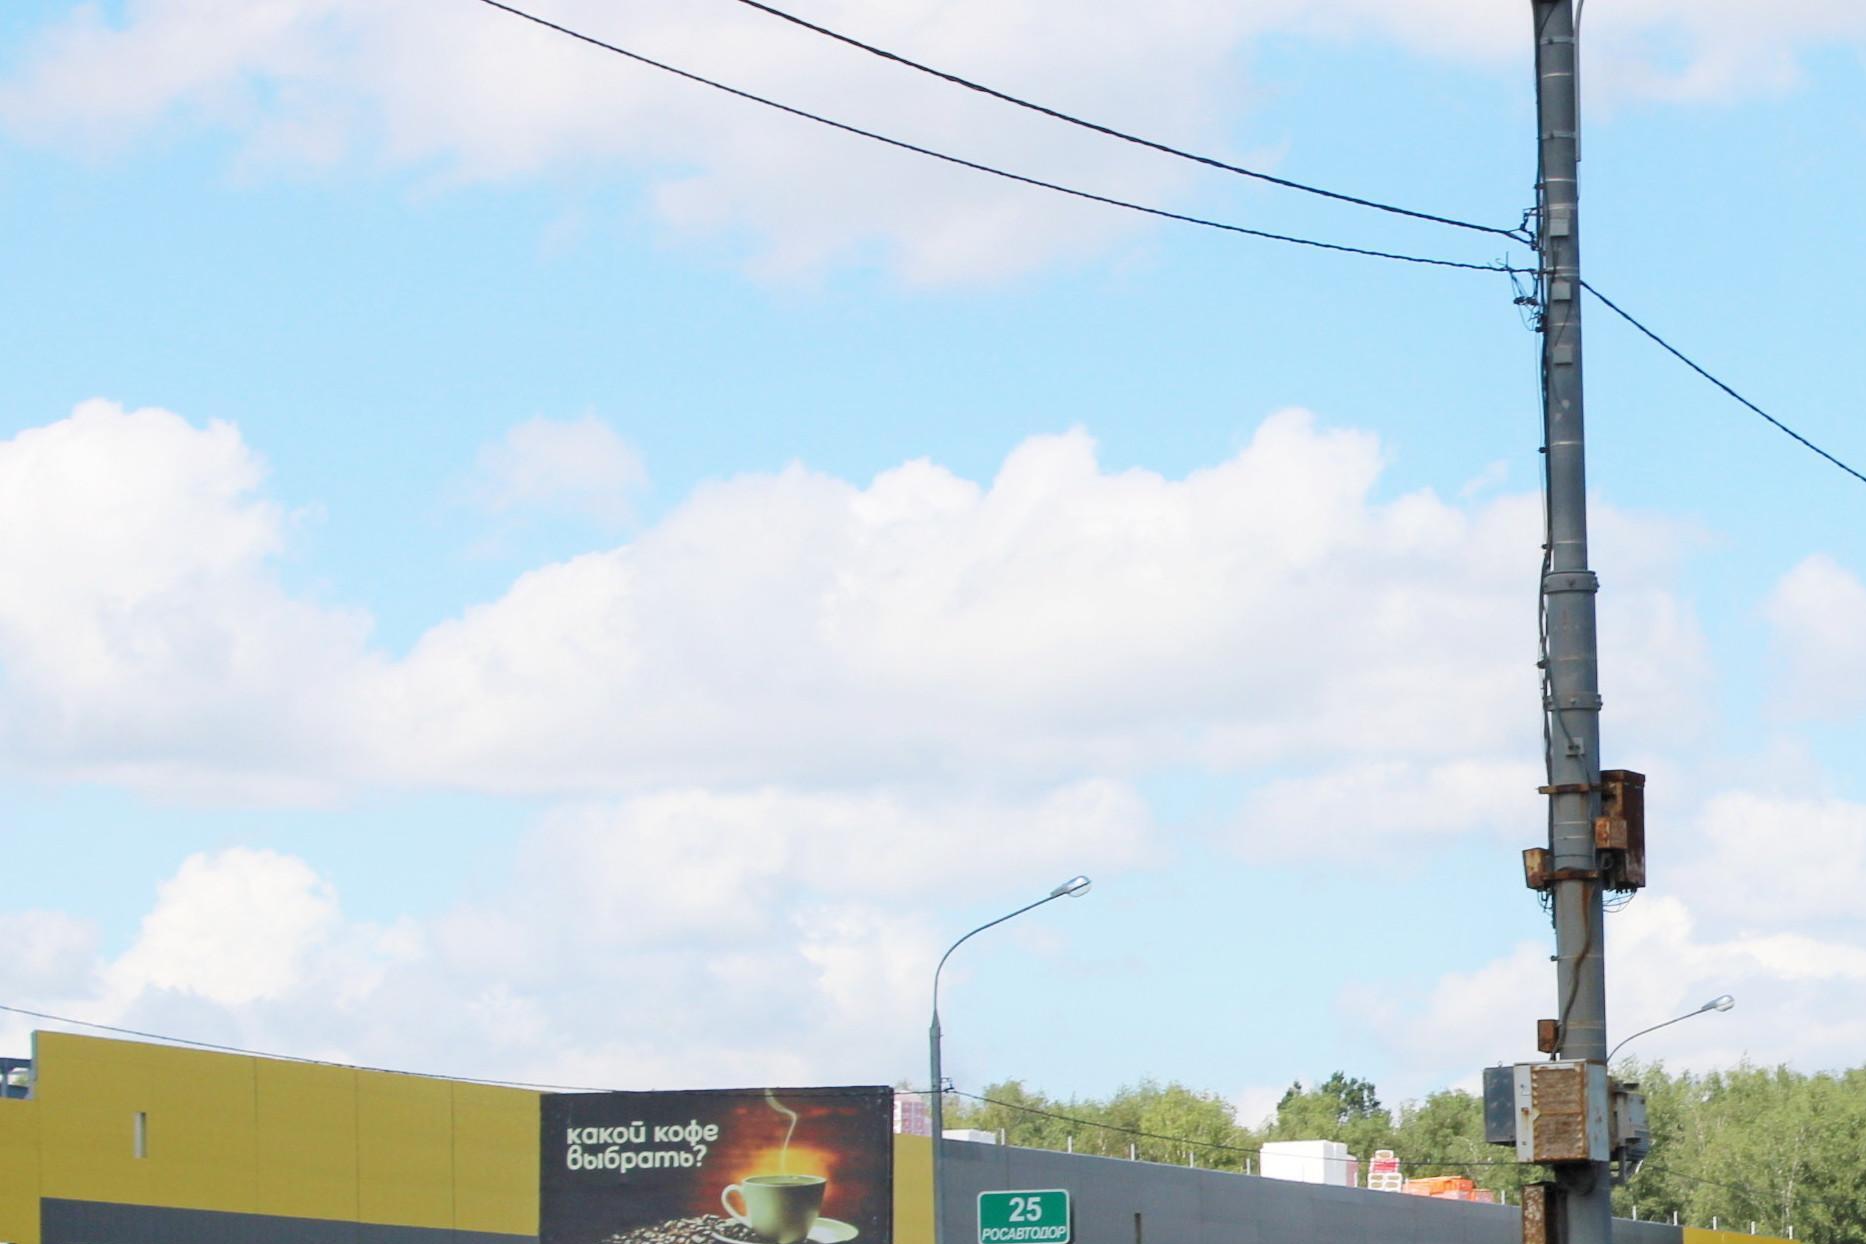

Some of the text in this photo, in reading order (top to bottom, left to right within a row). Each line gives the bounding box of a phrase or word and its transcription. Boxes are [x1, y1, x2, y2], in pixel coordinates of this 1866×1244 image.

[567, 1119, 719, 1146] какой кофе
[567, 1145, 708, 1174] выбрать?
[1008, 1196, 1042, 1222] 25
[981, 1226, 1067, 1241] РОСАВТОДОР
